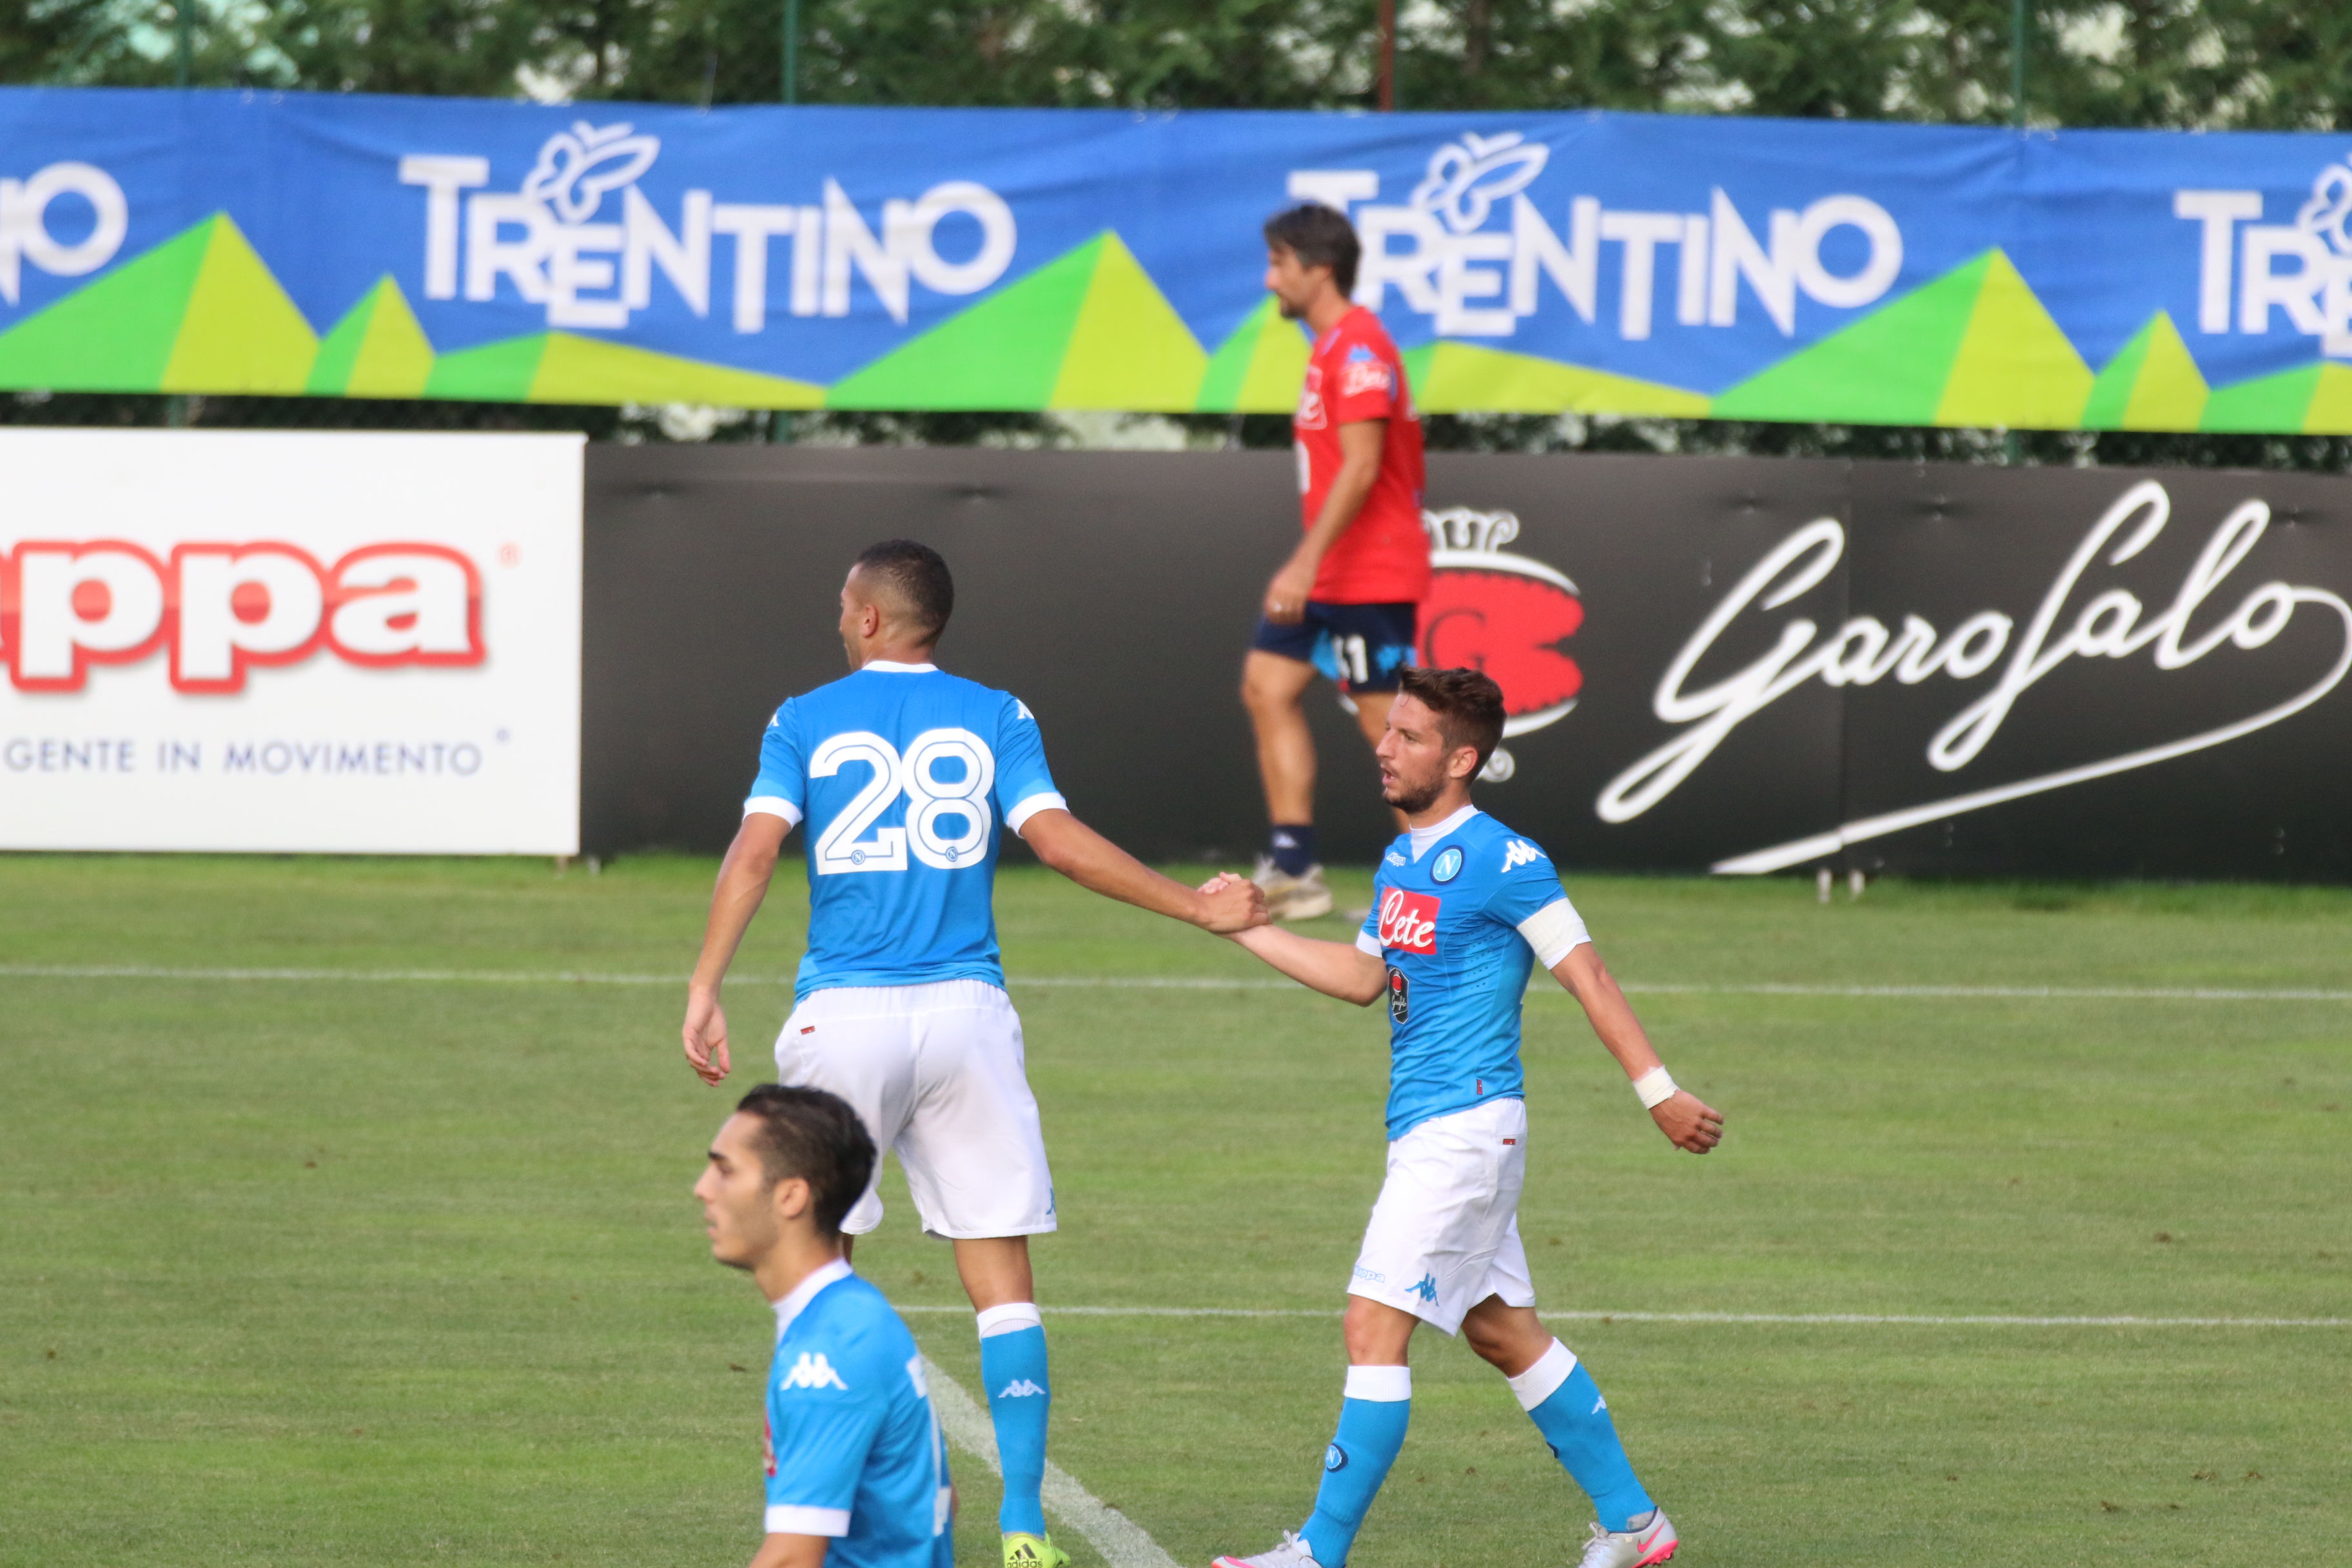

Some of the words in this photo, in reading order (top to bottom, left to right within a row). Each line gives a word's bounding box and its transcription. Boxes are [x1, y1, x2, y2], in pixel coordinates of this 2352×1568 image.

[398, 153, 1018, 334] TRENTINO
[0, 539, 487, 694] ppa
[1596, 478, 2315, 824] Garofalo
[3, 738, 136, 773] GENTE
[157, 741, 202, 773] IN
[223, 741, 482, 776] MOVIMENTO
[809, 728, 995, 876] 28
[1436, 854, 1458, 876] N
[1379, 890, 1435, 948] Lete
[1006, 1559, 1043, 1568] adidas
